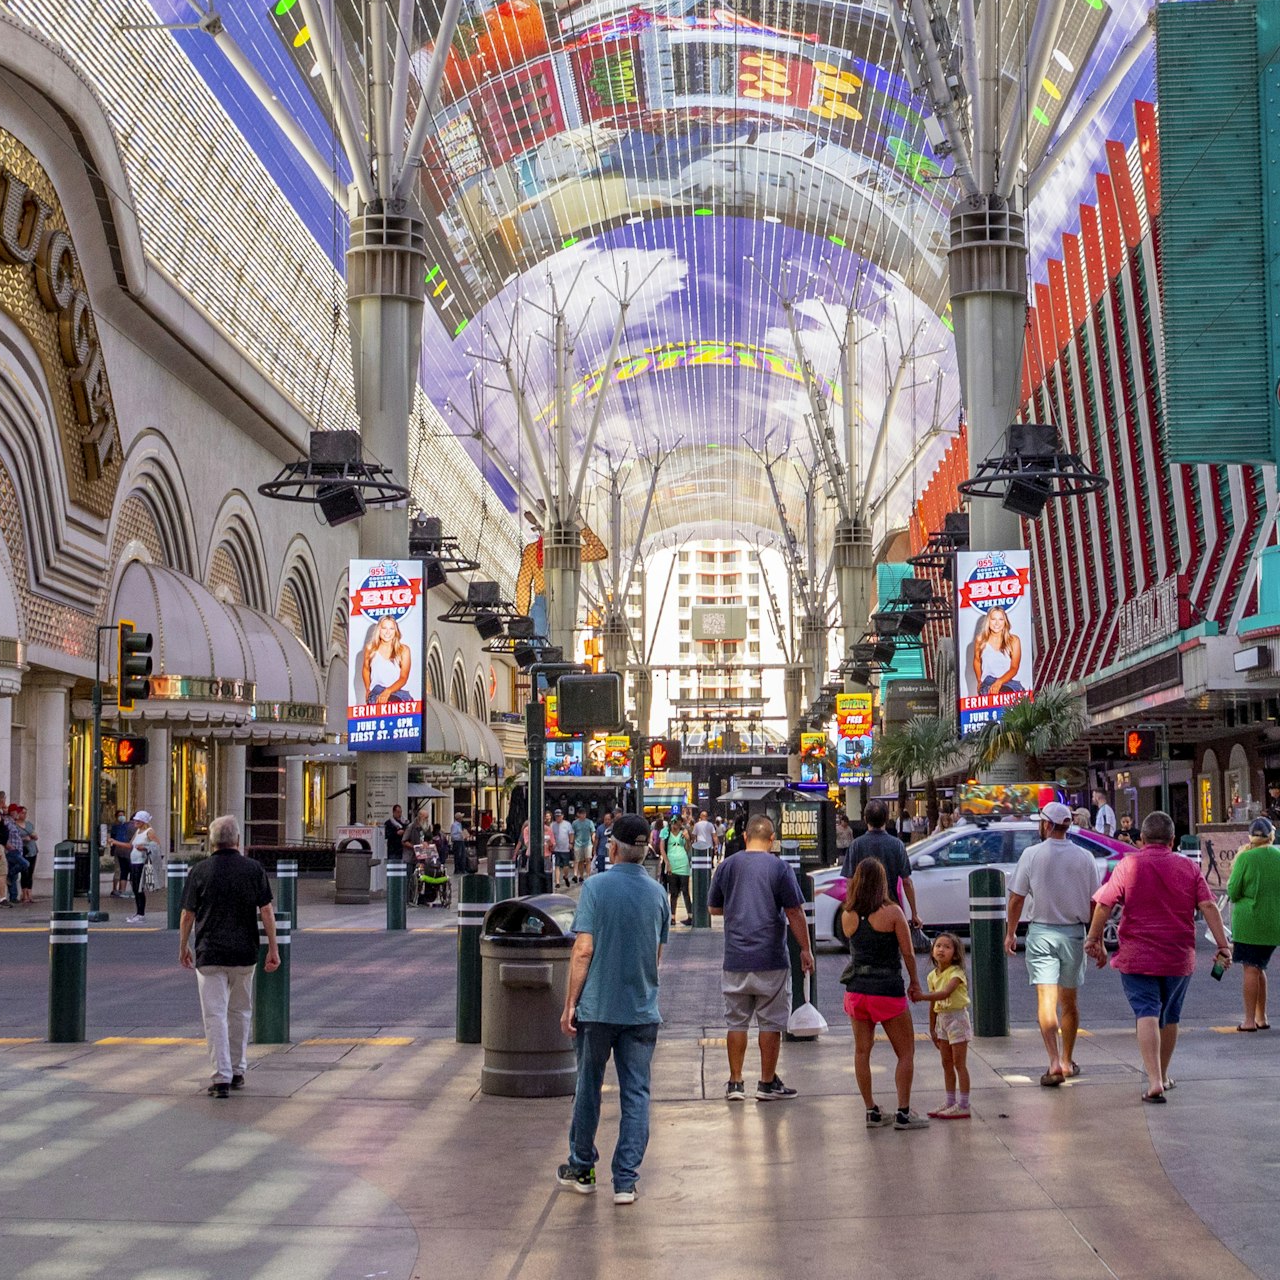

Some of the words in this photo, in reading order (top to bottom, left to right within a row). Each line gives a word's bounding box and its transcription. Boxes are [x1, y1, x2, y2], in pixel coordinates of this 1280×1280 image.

[976, 570, 1008, 579] NEXT
[368, 579, 401, 588] NEXT
[968, 579, 1022, 598] BIG
[360, 588, 413, 607] BIG
[977, 597, 1014, 608] THING
[368, 607, 406, 616] THING
[965, 697, 988, 709] ERIN
[352, 705, 377, 718] ERIN
[381, 701, 418, 715] KINSEY
[846, 716, 863, 724] FREE
[969, 711, 989, 723] JUNE
[992, 710, 998, 720] 6
[357, 720, 377, 732] JUNE
[380, 720, 385, 729] 6
[397, 717, 413, 728] 6PM
[350, 731, 375, 743] FIRST
[376, 730, 391, 740] ST.
[393, 727, 420, 739] STAGE
[782, 810, 818, 823] GORDIE
[781, 823, 818, 835] BROWN
